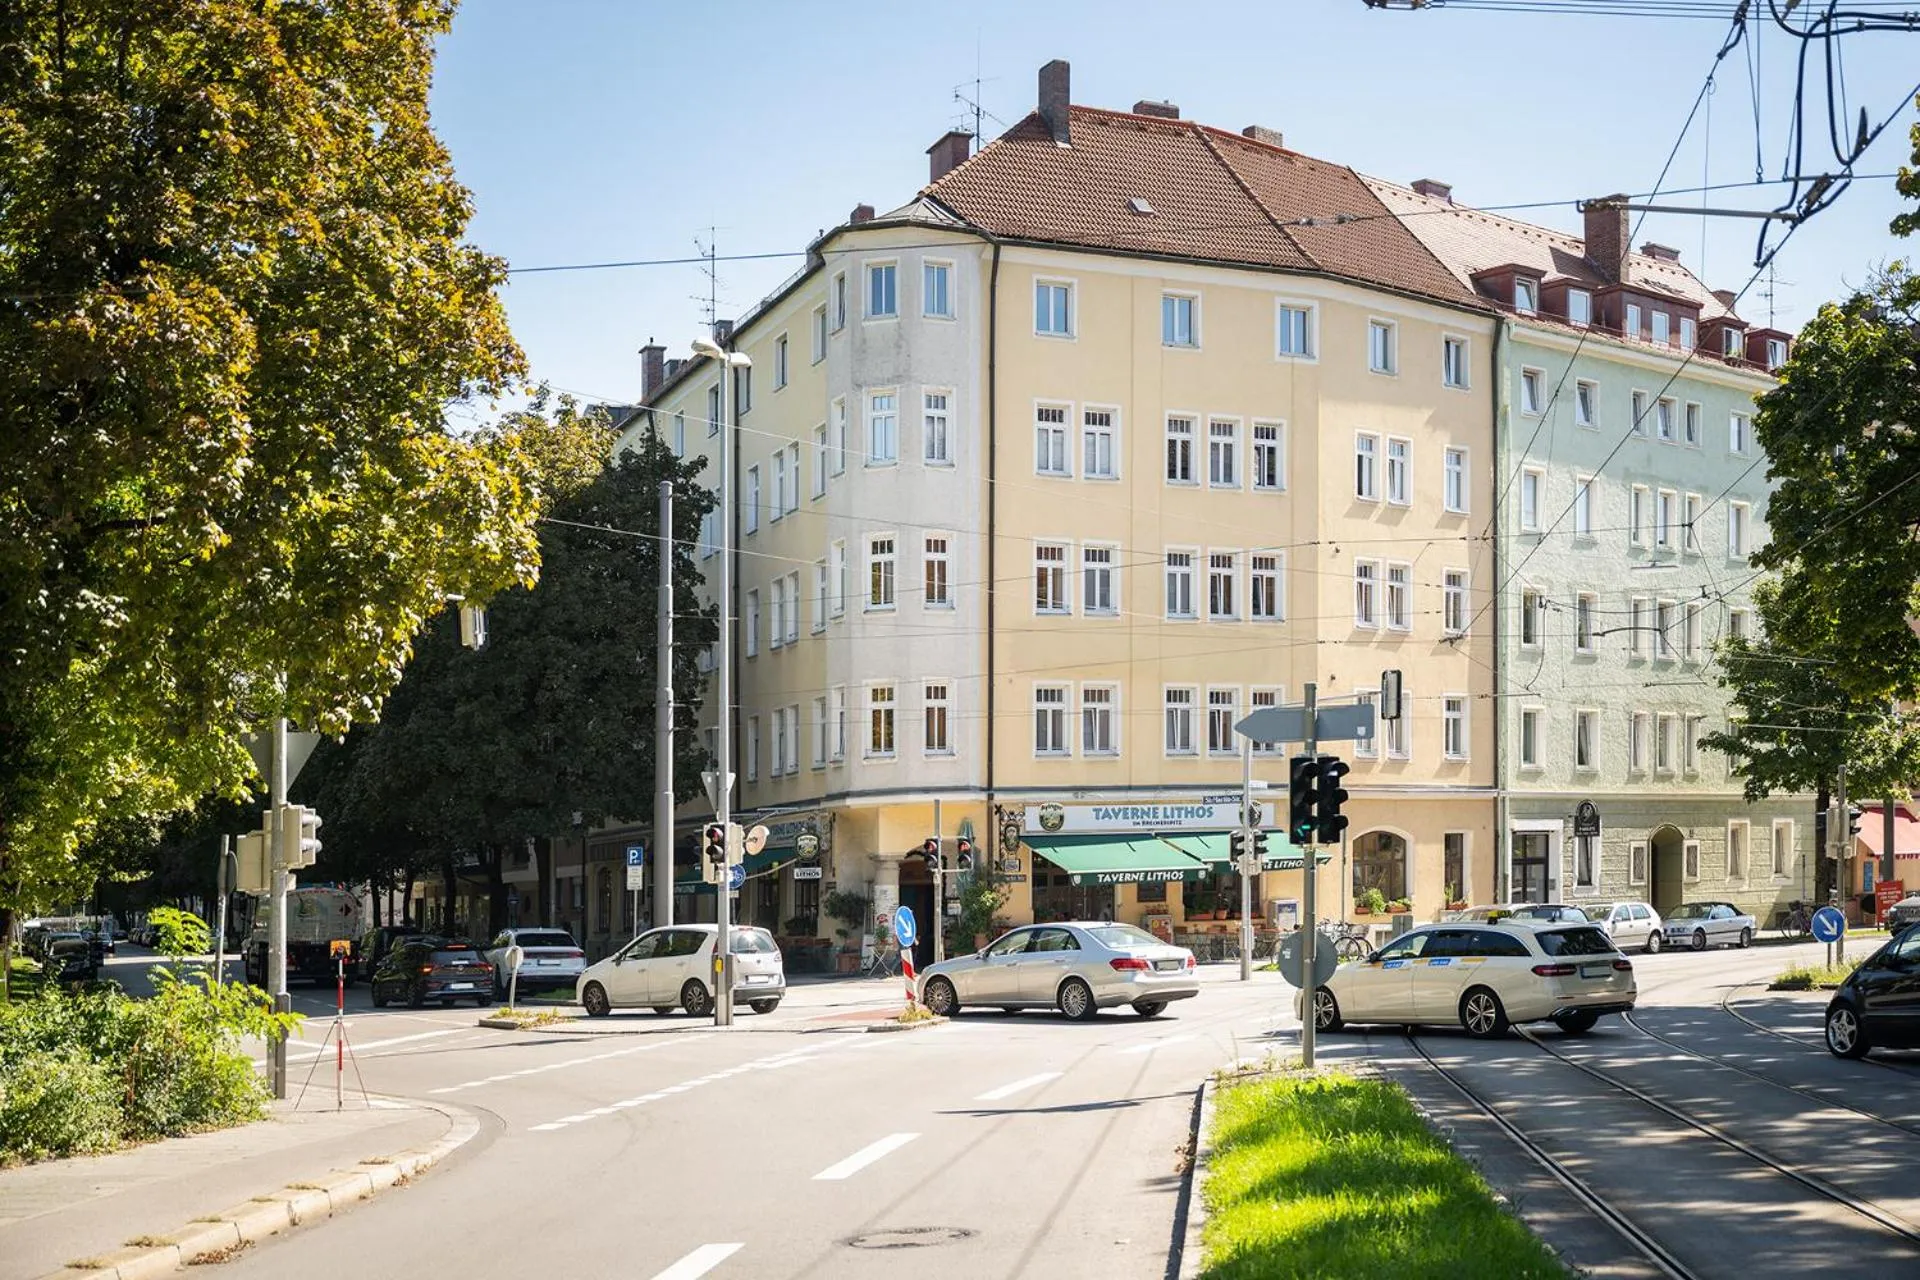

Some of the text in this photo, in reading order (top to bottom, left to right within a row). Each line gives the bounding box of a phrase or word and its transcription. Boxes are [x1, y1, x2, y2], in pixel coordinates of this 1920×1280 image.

[1092, 806, 1214, 820] TAVERNE LITHOS
[629, 849, 638, 865] P
[1274, 859, 1304, 869] LITHO
[1097, 870, 1184, 883] TAVERNE LITHOS
